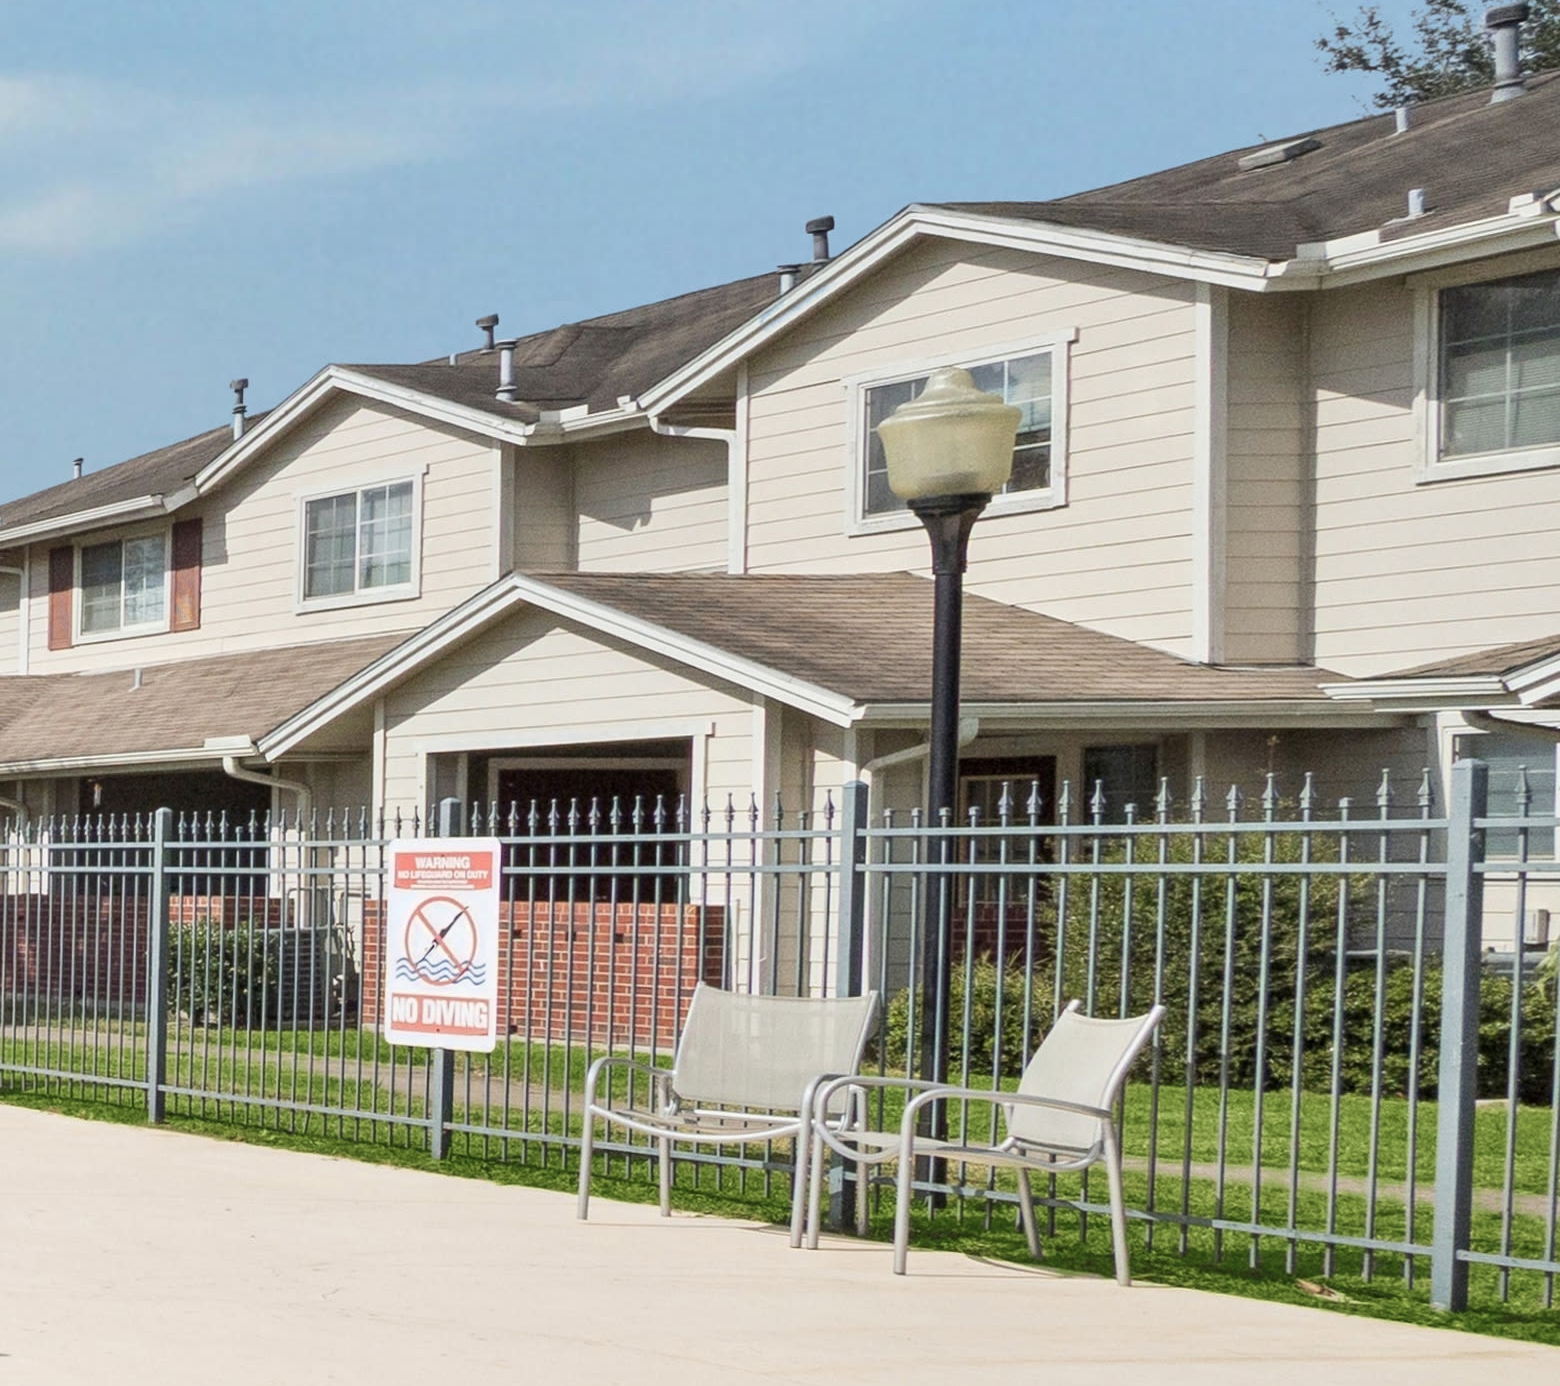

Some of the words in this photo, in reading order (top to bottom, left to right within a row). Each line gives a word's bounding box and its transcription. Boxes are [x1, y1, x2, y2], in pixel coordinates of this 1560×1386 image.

[415, 856, 470, 869] WARNING
[398, 869, 410, 879] NO
[454, 870, 466, 880] ON
[467, 870, 489, 880] DUTY
[392, 996, 419, 1024] NO
[422, 998, 488, 1029] DIVING
